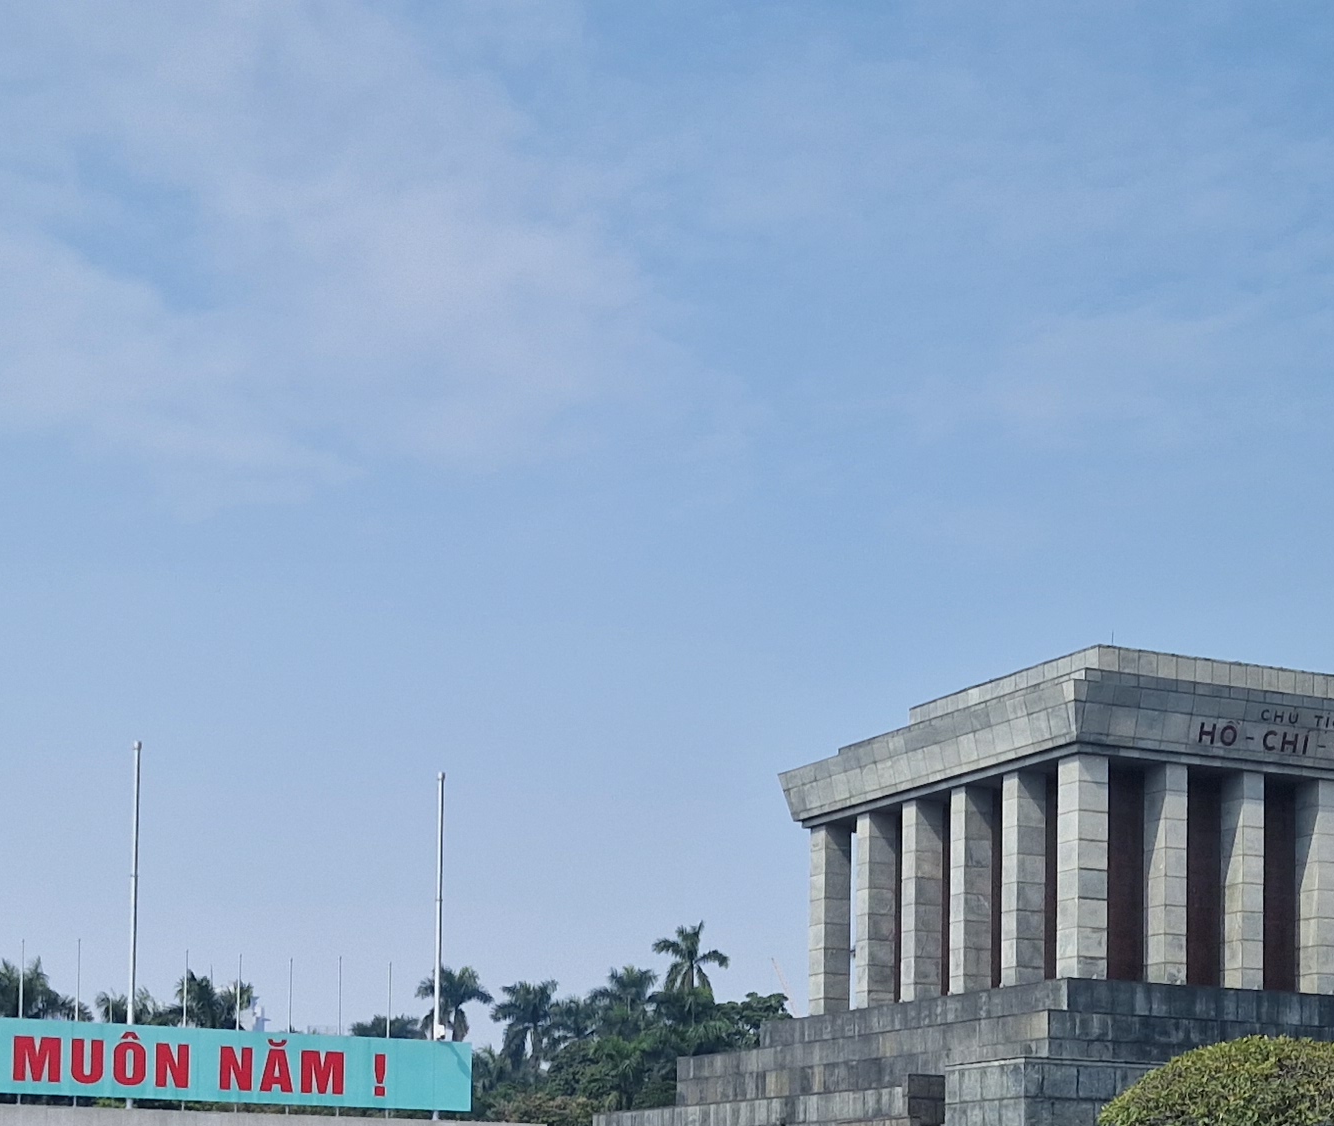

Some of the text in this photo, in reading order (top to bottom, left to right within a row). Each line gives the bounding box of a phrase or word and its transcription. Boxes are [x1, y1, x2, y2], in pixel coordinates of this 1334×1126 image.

[1198, 720, 1242, 747] HỒ
[1262, 728, 1312, 755] CHÍ
[12, 1031, 190, 1089] MUÔN
[219, 1038, 345, 1096] NĂM
